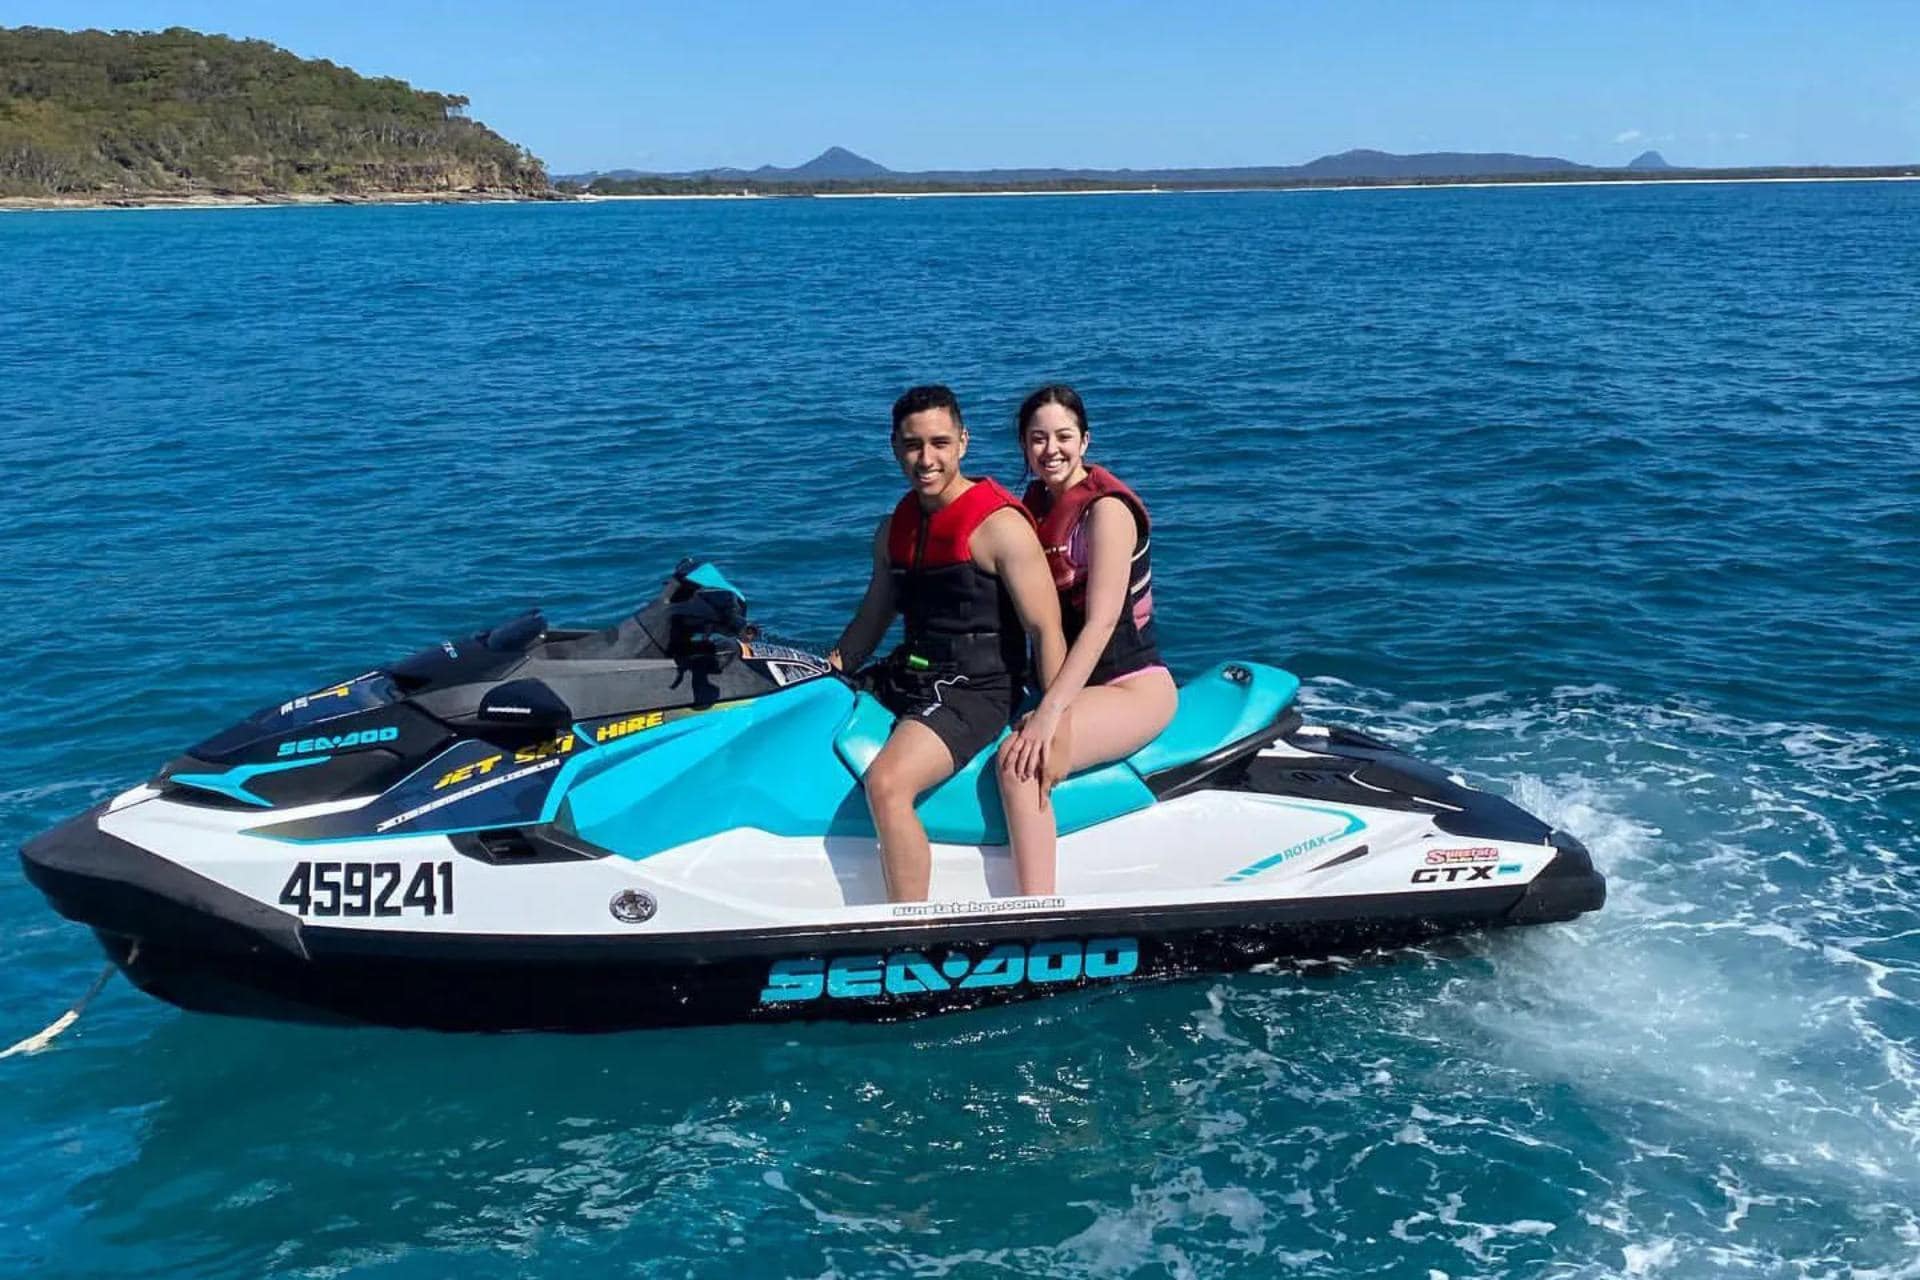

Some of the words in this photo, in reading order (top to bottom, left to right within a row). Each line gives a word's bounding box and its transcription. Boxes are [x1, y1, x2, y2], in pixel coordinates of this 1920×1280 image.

[433, 754, 503, 790] JET
[596, 711, 664, 742] HIRE
[1284, 836, 1327, 860] ROTAX
[278, 861, 454, 917] 459241
[1410, 865, 1496, 883] GTX
